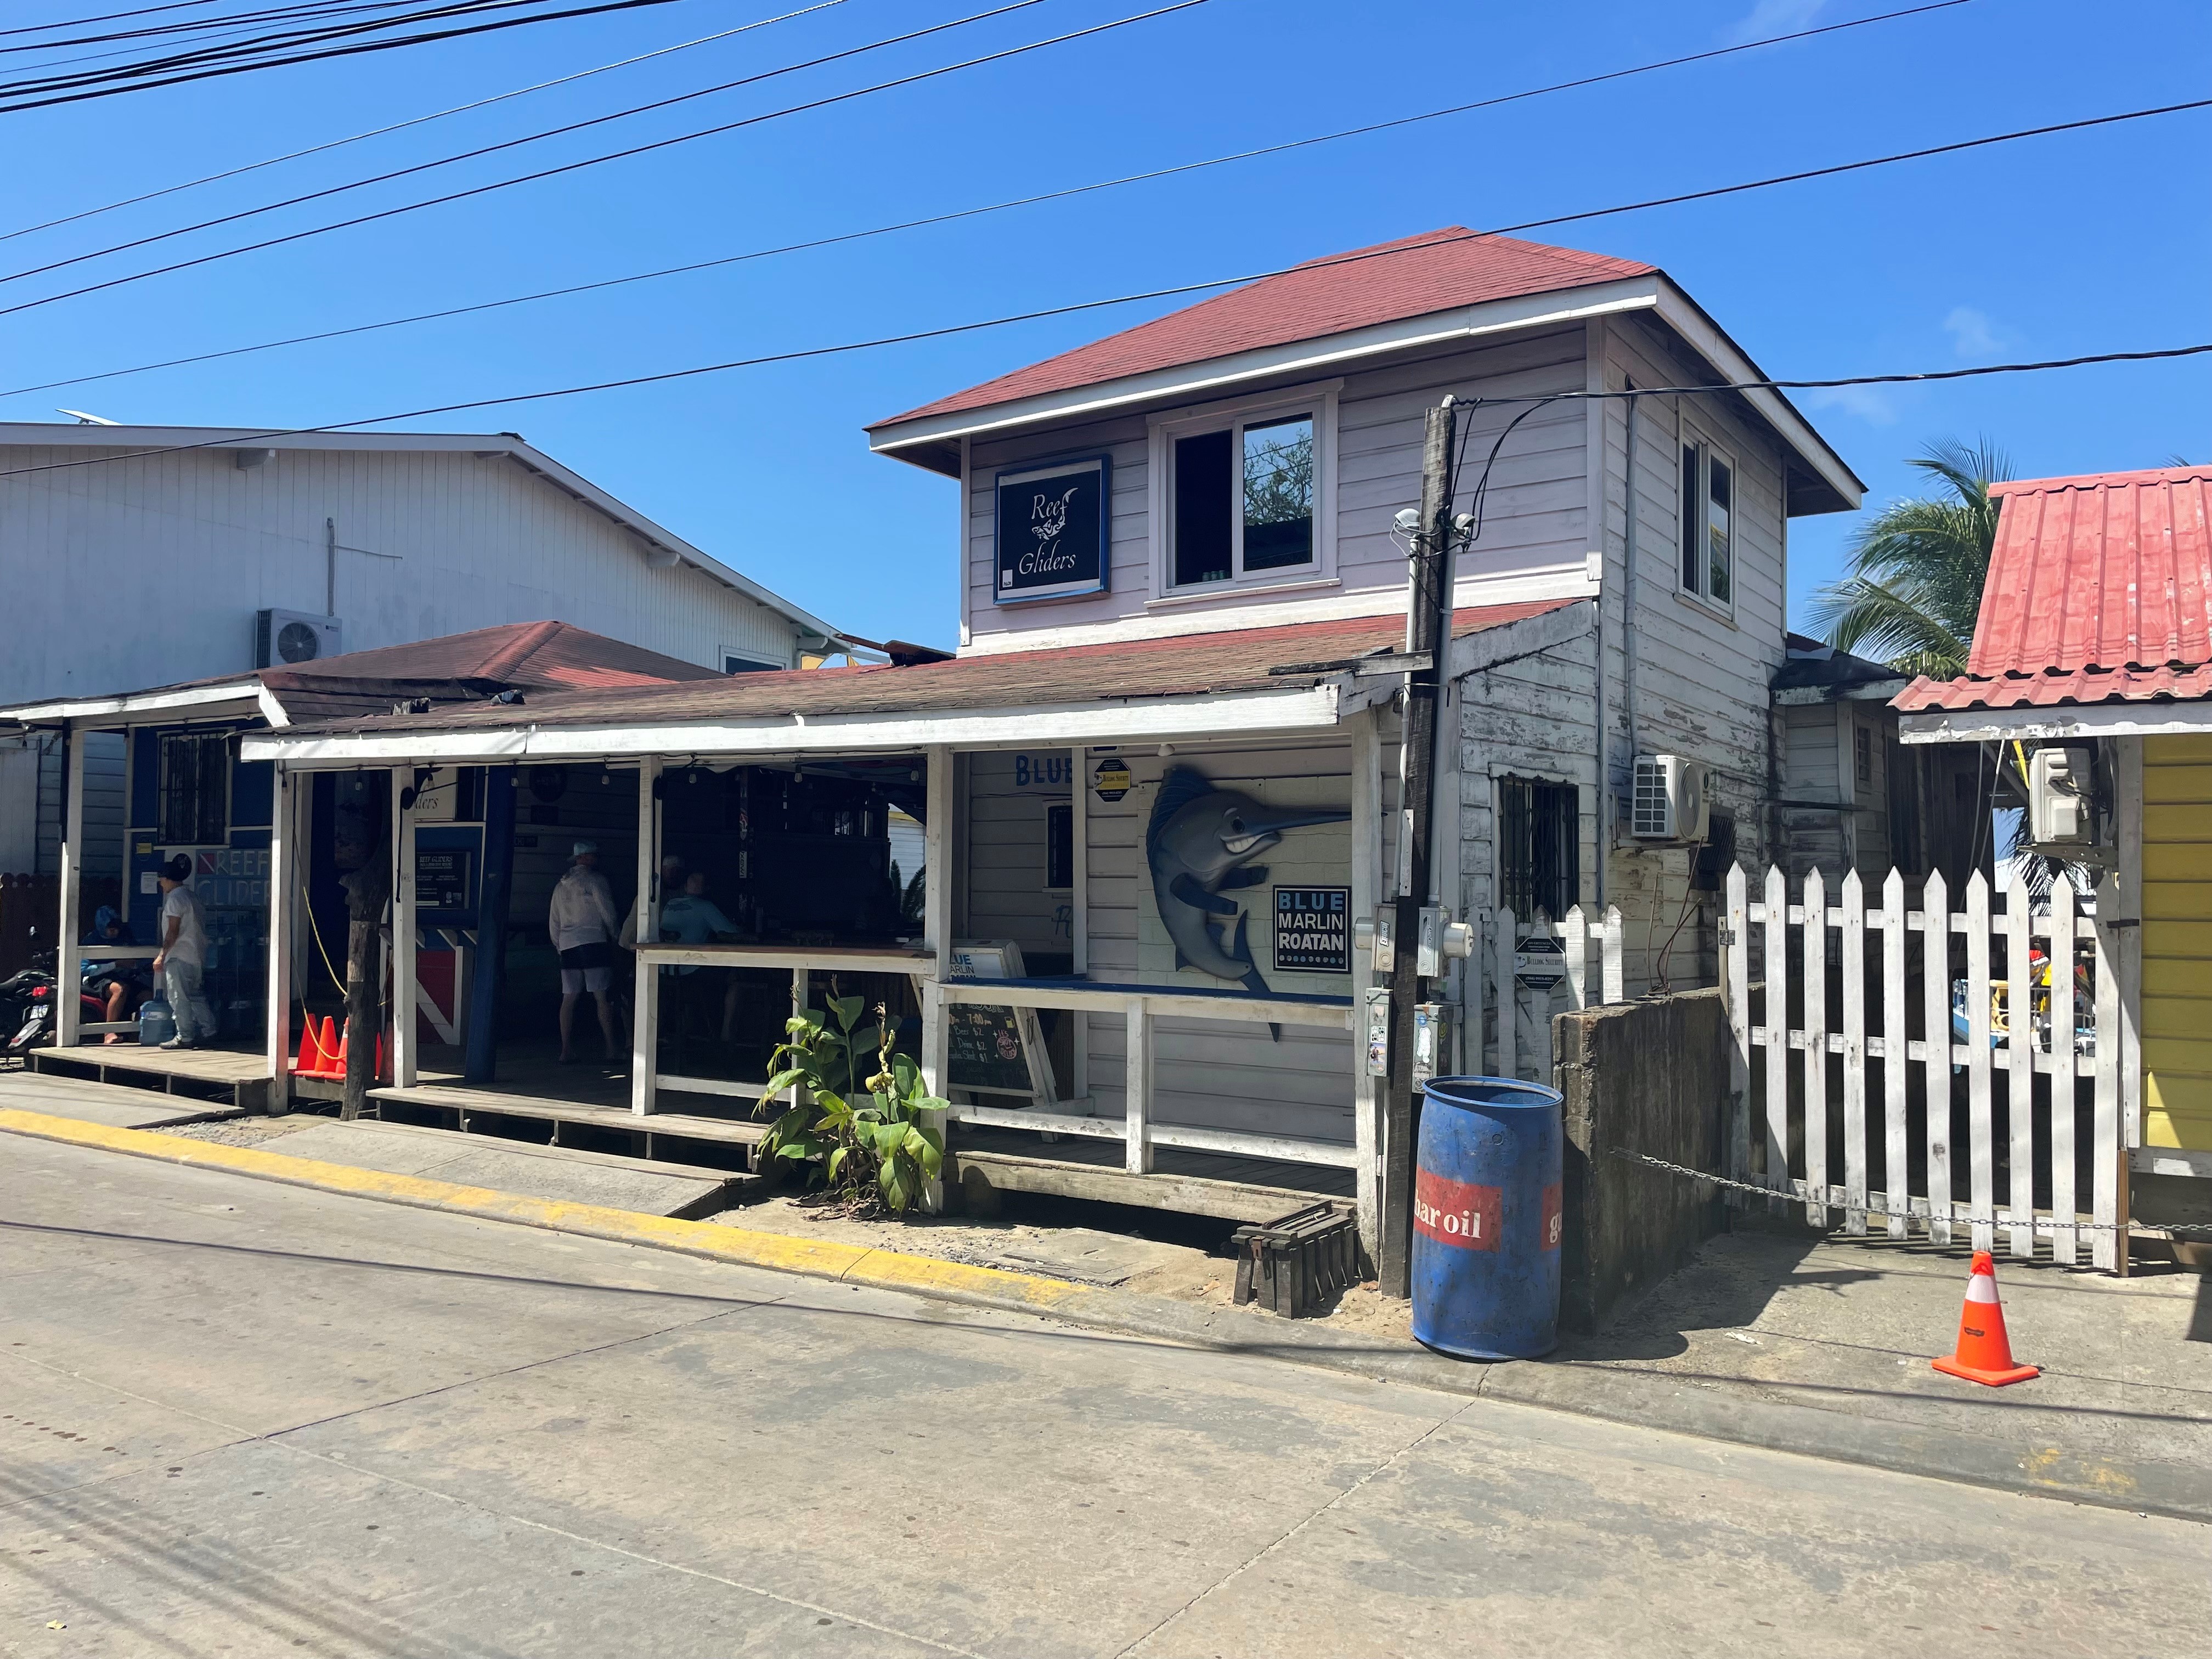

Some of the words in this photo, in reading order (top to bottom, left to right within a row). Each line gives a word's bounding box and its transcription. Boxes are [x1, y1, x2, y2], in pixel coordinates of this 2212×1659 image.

[1031, 488, 1079, 519] Reef
[1019, 540, 1076, 574] Gliders
[1016, 755, 1072, 786] BLUE
[415, 794, 438, 810] ders
[216, 850, 269, 876] REEF
[197, 879, 271, 906] GLIDER
[1279, 893, 1343, 910] BLUE
[1279, 913, 1343, 930] MARLIN
[1279, 932, 1344, 951] ROATAN
[950, 965, 974, 974] ARLIN
[1545, 956, 1563, 966] SECURITY
[1443, 1210, 1481, 1239] oil
